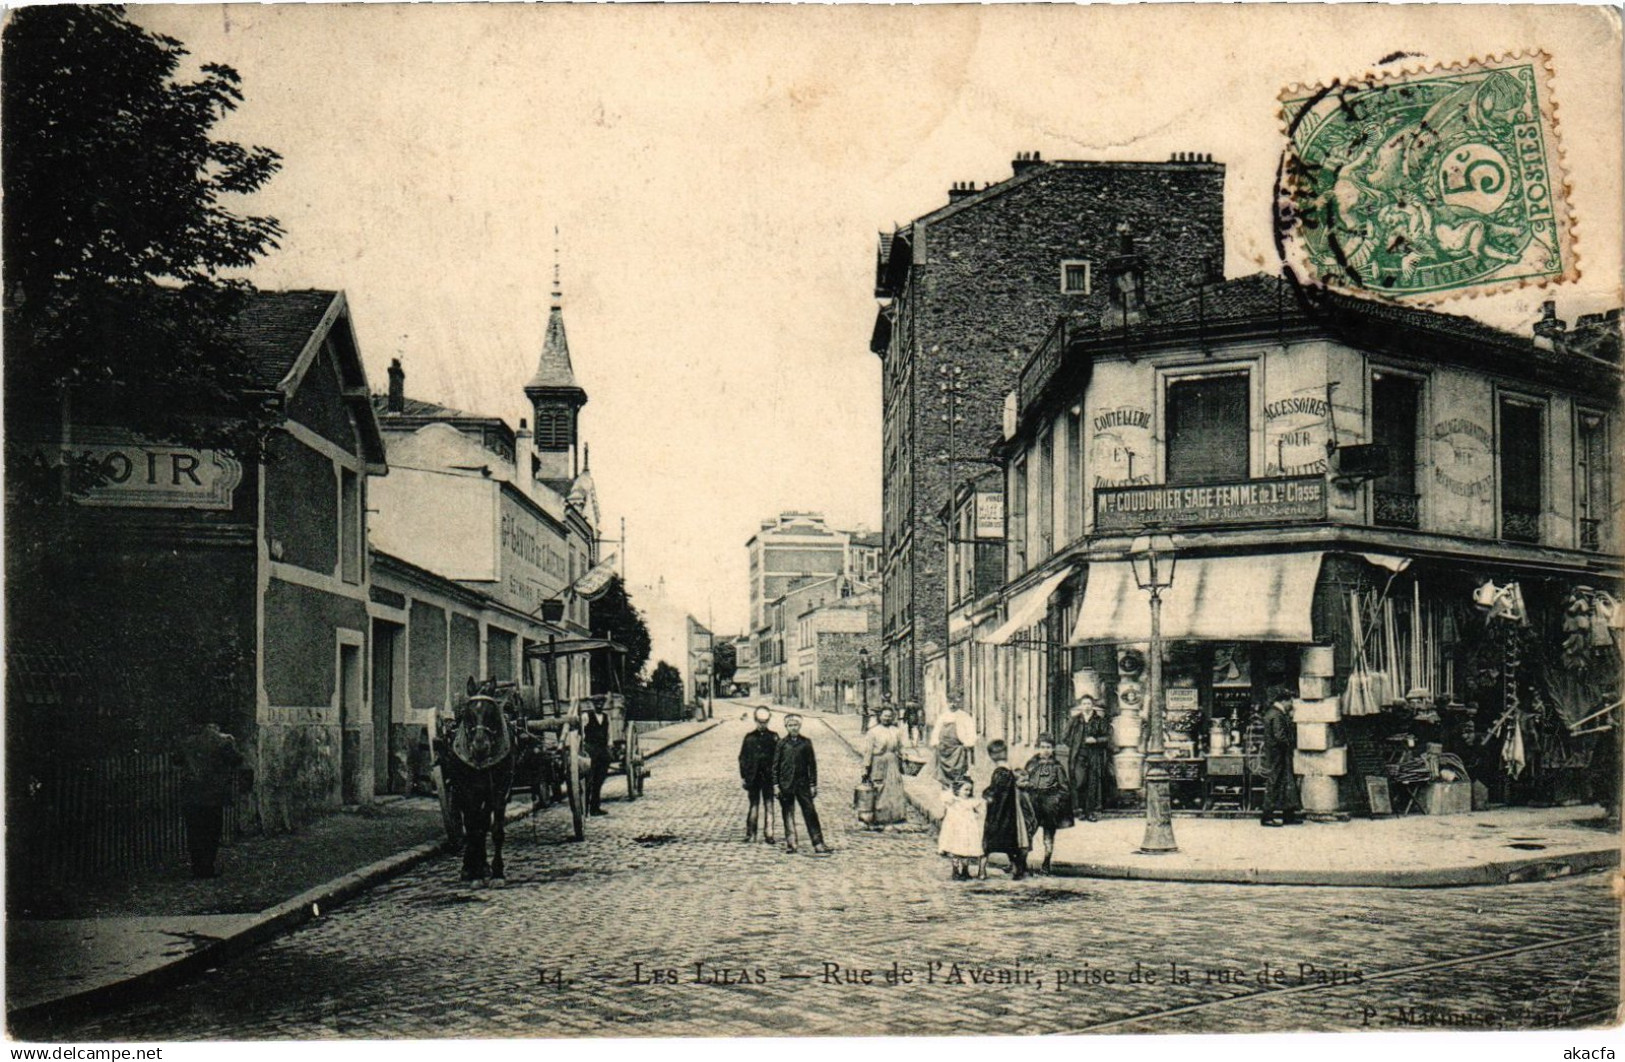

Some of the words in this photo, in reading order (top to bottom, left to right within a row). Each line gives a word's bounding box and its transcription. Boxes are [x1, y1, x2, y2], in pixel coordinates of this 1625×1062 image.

[1517, 126, 1550, 218] POSTES
[1263, 397, 1329, 420] ACCESSOIRES
[1093, 409, 1152, 432] COUTELLERIE
[1279, 430, 1312, 447] POUR
[1286, 482, 1321, 501] Classe
